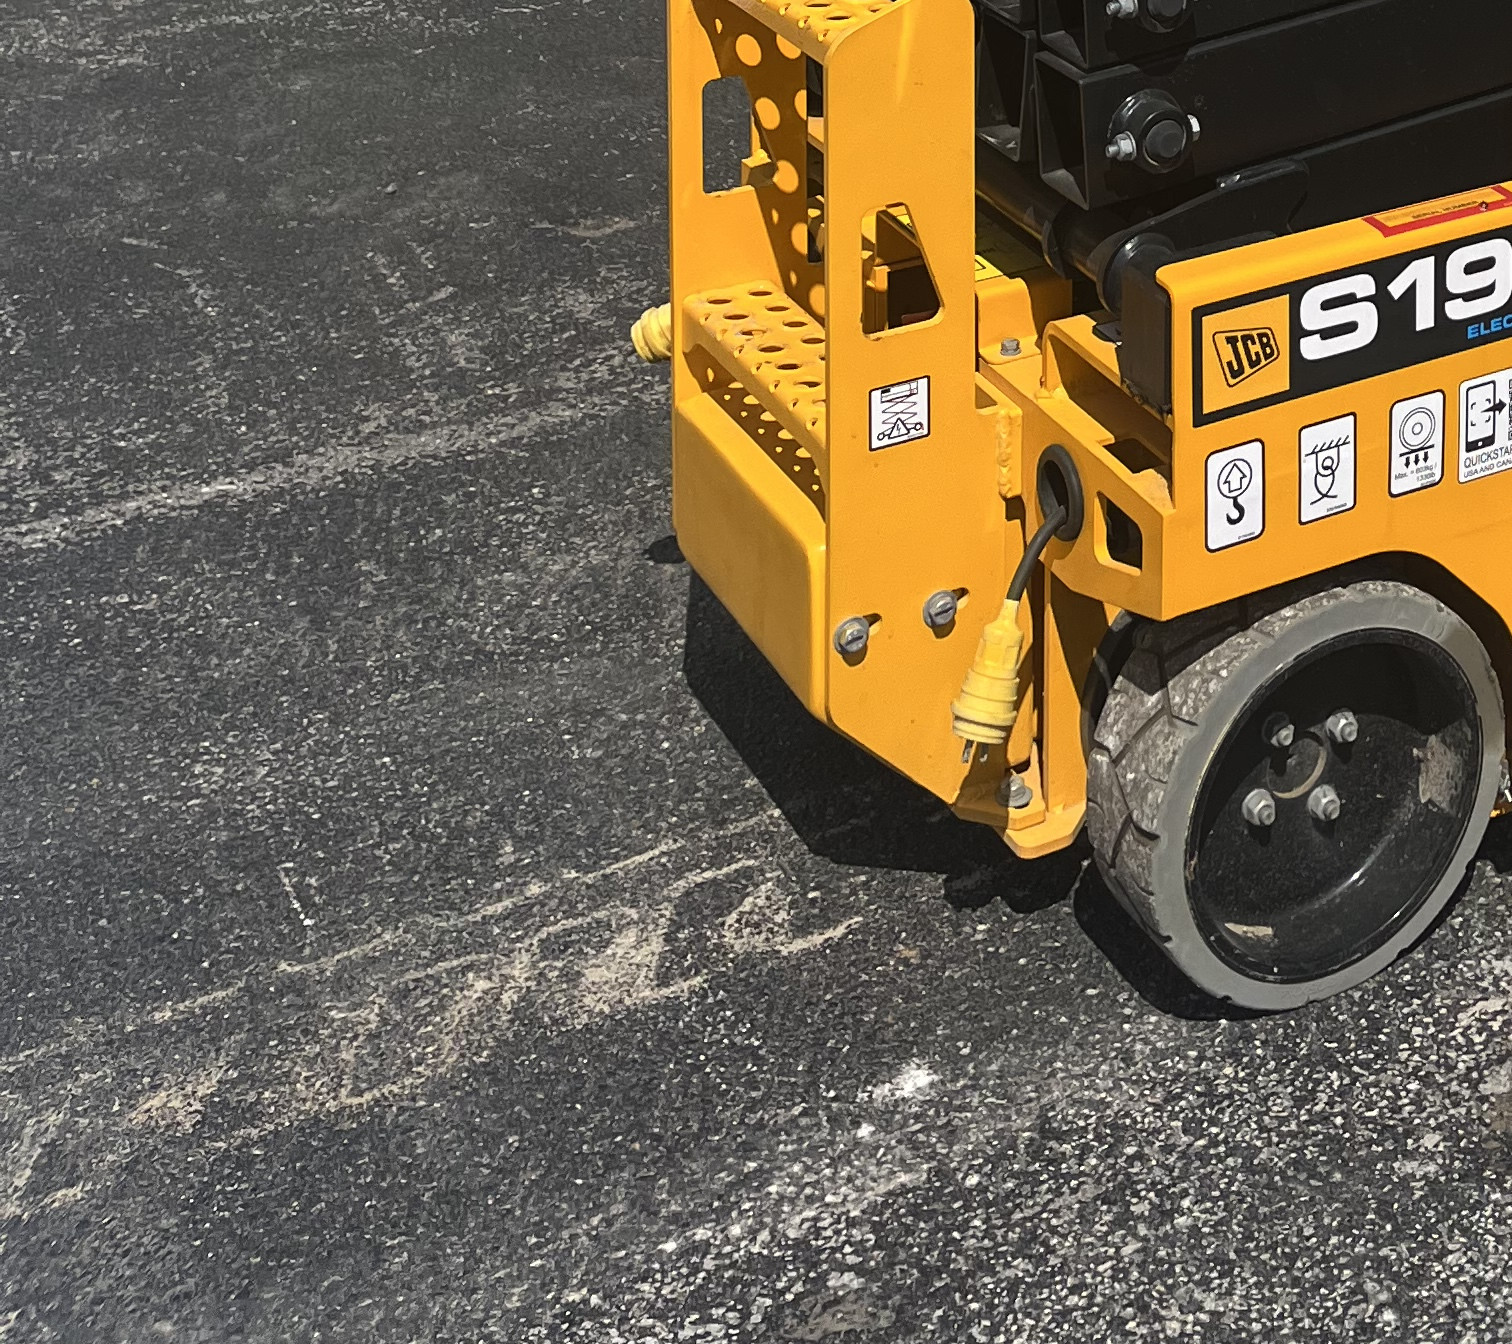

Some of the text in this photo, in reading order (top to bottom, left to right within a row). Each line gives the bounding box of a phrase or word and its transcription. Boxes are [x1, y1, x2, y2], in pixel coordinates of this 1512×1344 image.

[1225, 332, 1276, 380] JCB
[1463, 467, 1478, 479] USA
[1479, 462, 1495, 475] AND
